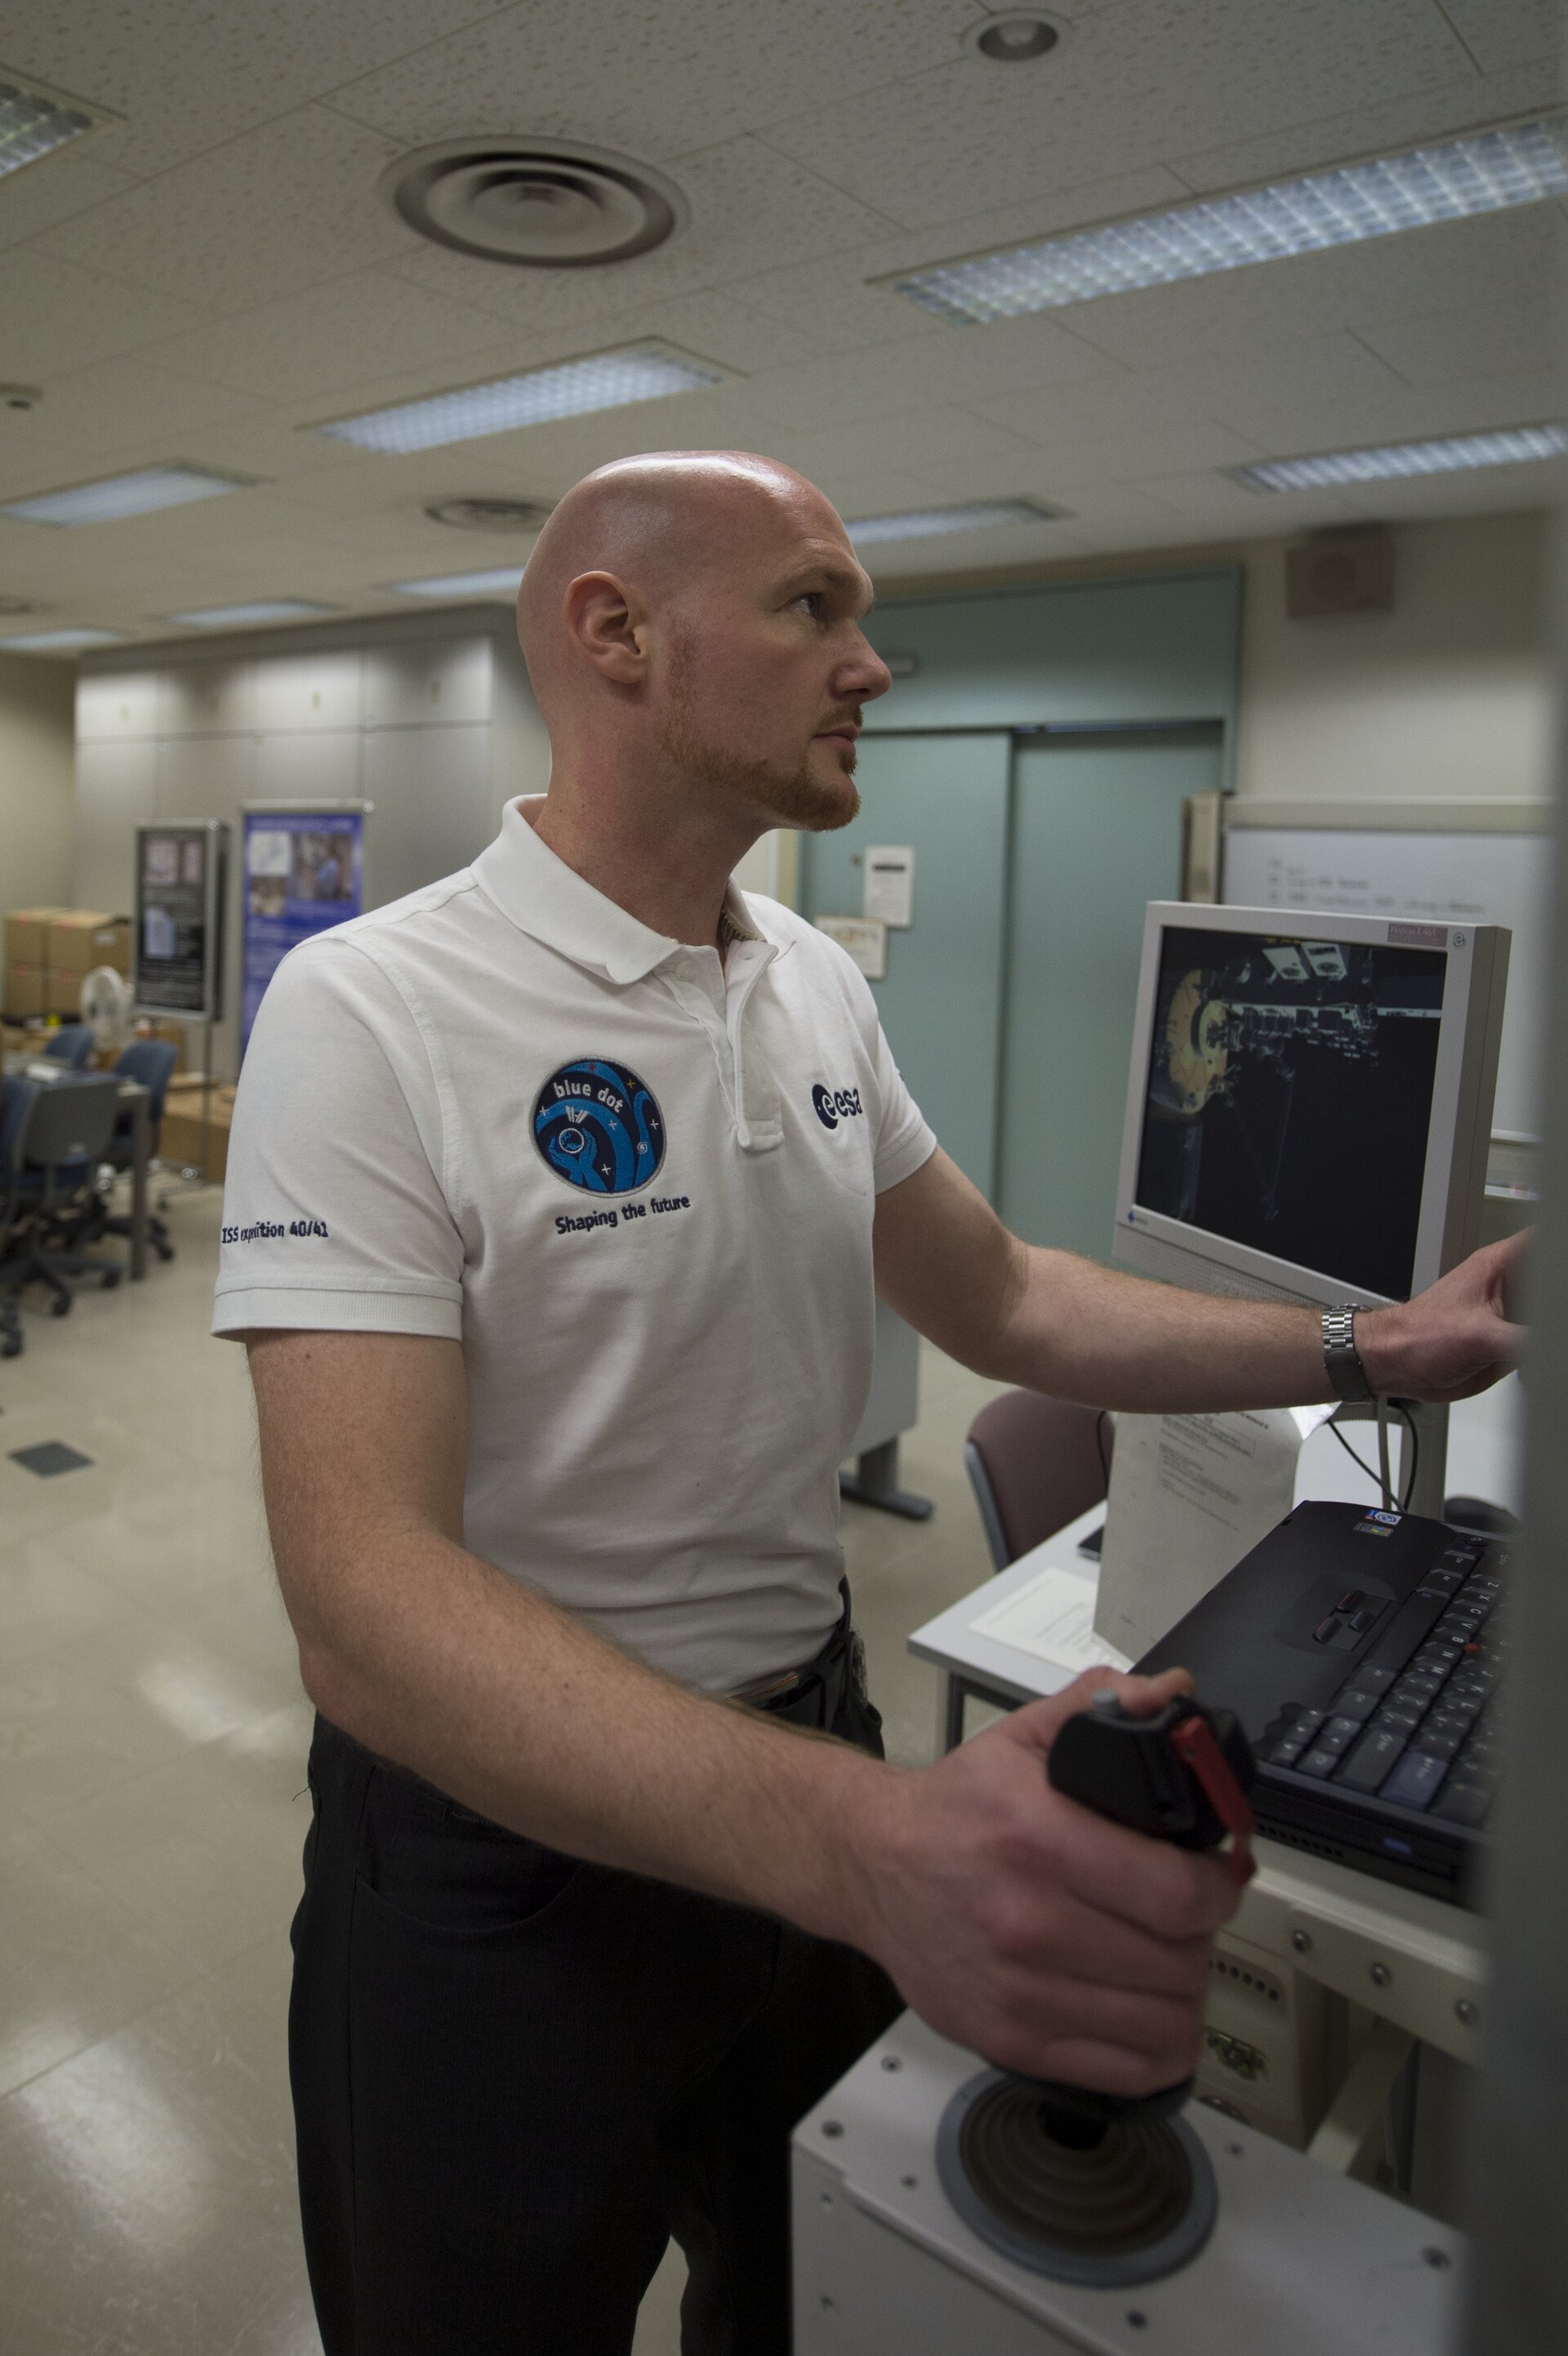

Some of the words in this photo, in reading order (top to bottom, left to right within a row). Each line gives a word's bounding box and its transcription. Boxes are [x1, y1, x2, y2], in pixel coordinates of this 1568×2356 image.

[553, 1079, 591, 1099] blue
[597, 1087, 624, 1113] dot
[221, 1227, 238, 1244] ISS
[290, 1220, 329, 1238] 40/41
[555, 1210, 618, 1235] Shaping
[621, 1203, 647, 1221] the
[650, 1196, 691, 1214] future
